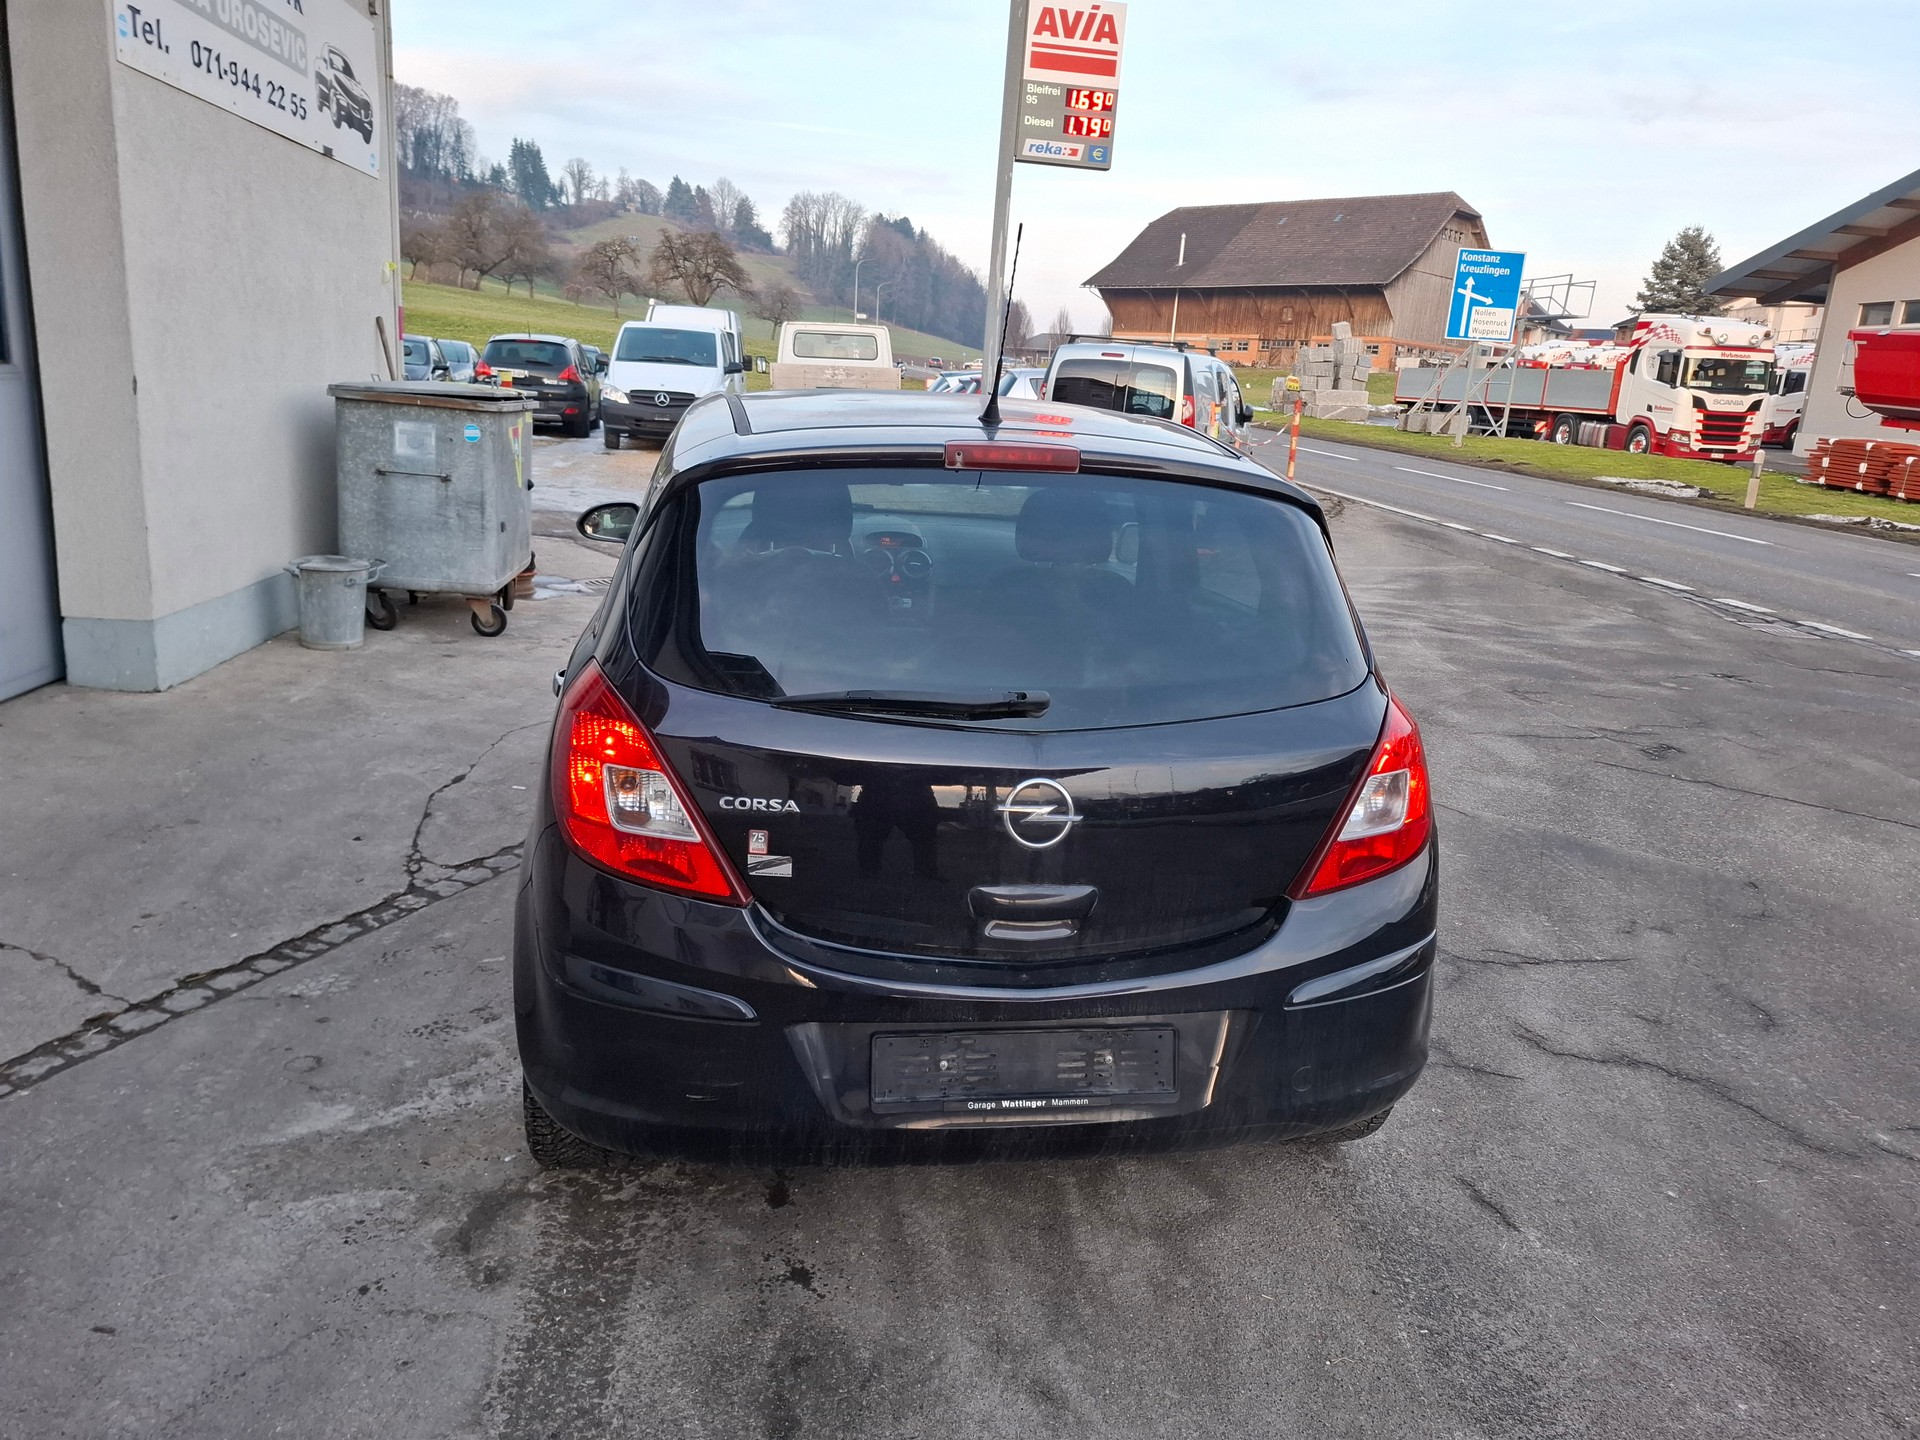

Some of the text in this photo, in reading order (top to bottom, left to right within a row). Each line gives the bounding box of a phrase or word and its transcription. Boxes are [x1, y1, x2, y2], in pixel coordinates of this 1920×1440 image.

[127, 5, 169, 54] Tel.
[266, 80, 286, 111] 22
[290, 93, 307, 120] 55
[1027, 83, 1061, 96] Bleifrei
[1026, 95, 1038, 105] 95
[1024, 116, 1054, 128] Diesel
[1461, 251, 1501, 263] Konstanz
[1460, 263, 1510, 277] Kreuzlingen
[1474, 309, 1497, 317] Nollen
[1473, 318, 1508, 327] Hosenruck
[1471, 328, 1508, 336] Wuppenau
[1712, 398, 1744, 407] SCANIA
[719, 796, 800, 813] CORSA
[752, 832, 765, 843] 75
[967, 1098, 1089, 1110] Garage Wattinger Mammern
